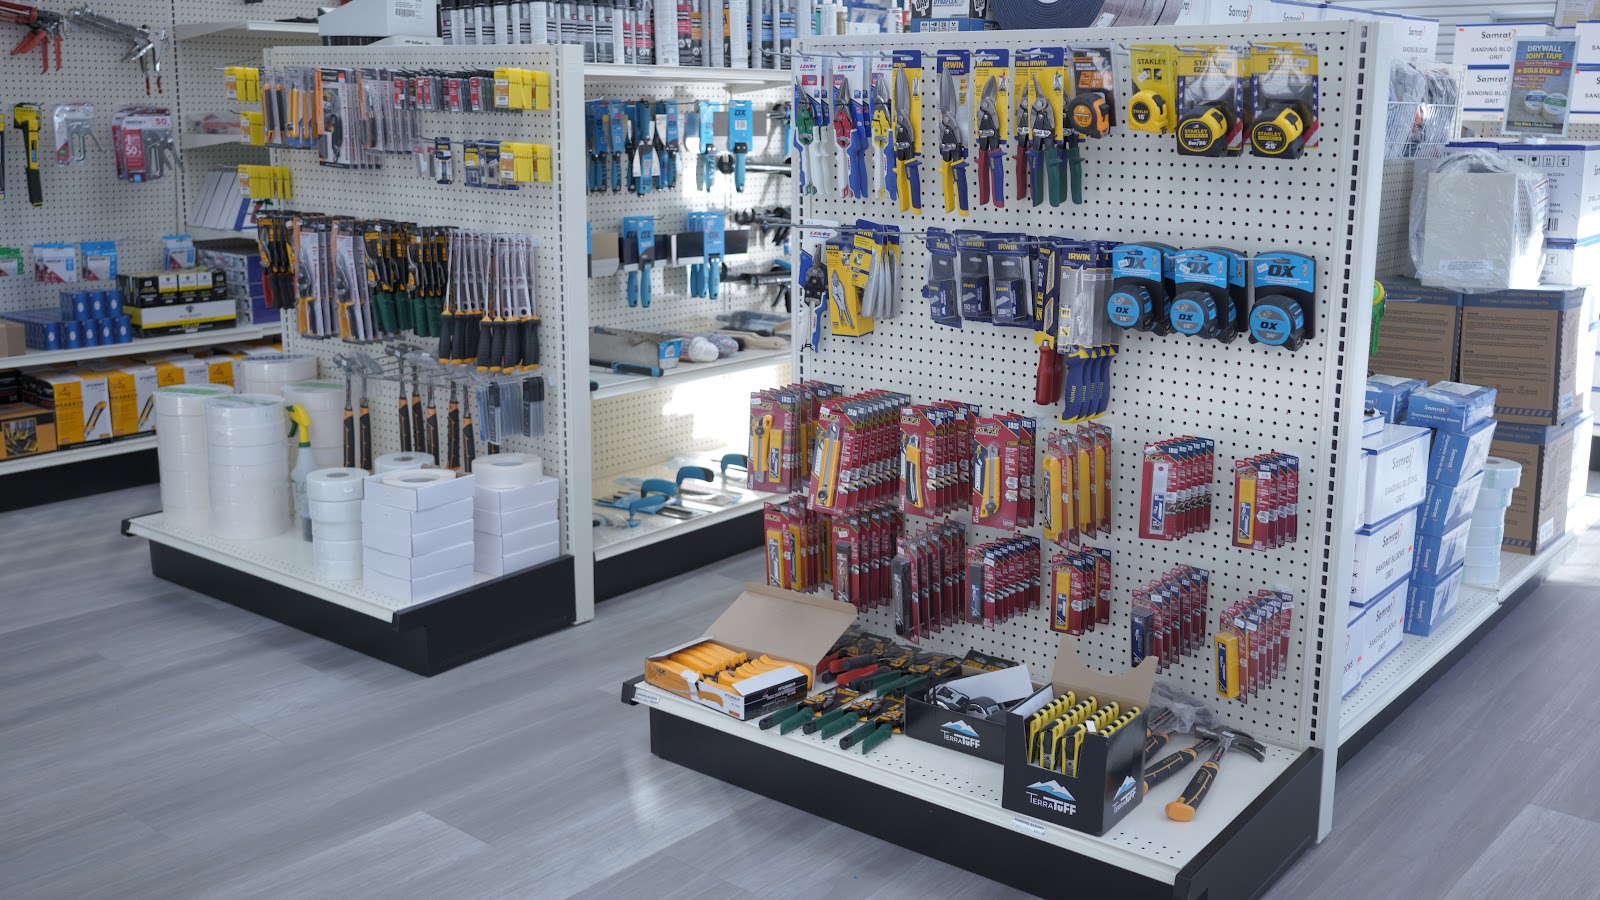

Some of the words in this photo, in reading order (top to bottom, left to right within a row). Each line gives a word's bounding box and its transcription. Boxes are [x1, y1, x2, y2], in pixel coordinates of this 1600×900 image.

[1228, 5, 1250, 19] Samrat
[1481, 30, 1512, 40] Samrat
[1527, 44, 1562, 52] DRYWALL
[1477, 74, 1507, 83] Samrat
[1068, 252, 1092, 260] IRWIN
[1125, 256, 1148, 268] OX
[1186, 261, 1210, 274] OX
[1268, 264, 1296, 278] OX
[1260, 322, 1278, 330] OX
[1424, 404, 1445, 413] Samrat
[1448, 448, 1458, 468] Samrat
[1432, 498, 1442, 518] Samrat
[1382, 530, 1400, 548] Samrat
[1375, 556, 1392, 574] SANDING
[1391, 548, 1405, 564] BLOCKS
[1424, 548, 1432, 568] Samrat
[1376, 602, 1392, 622] Samrat
